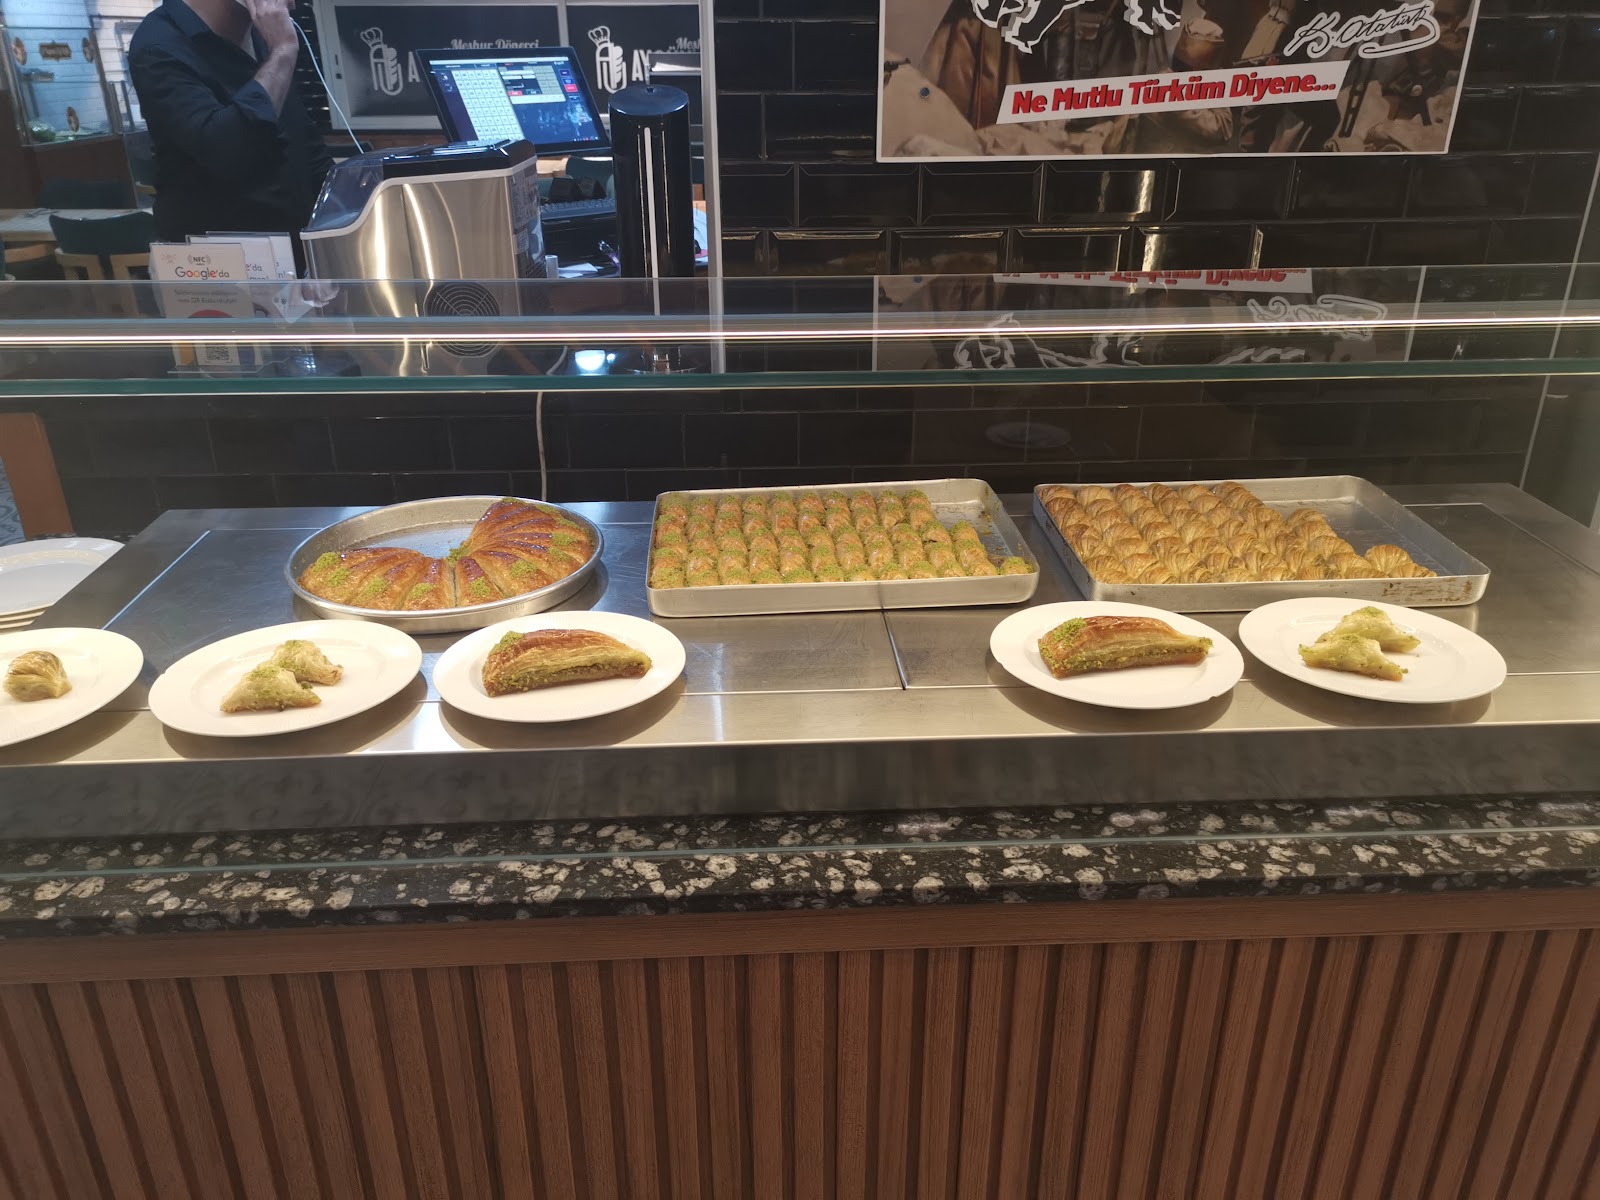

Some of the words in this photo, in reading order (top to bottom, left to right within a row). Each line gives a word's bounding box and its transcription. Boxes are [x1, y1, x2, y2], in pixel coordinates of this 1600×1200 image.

[1012, 90, 1047, 114] Ne
[1052, 84, 1123, 111] Mutlu
[1129, 76, 1225, 105] Türküm
[1229, 72, 1336, 102] Diyene...
[175, 266, 230, 280] Google'da
